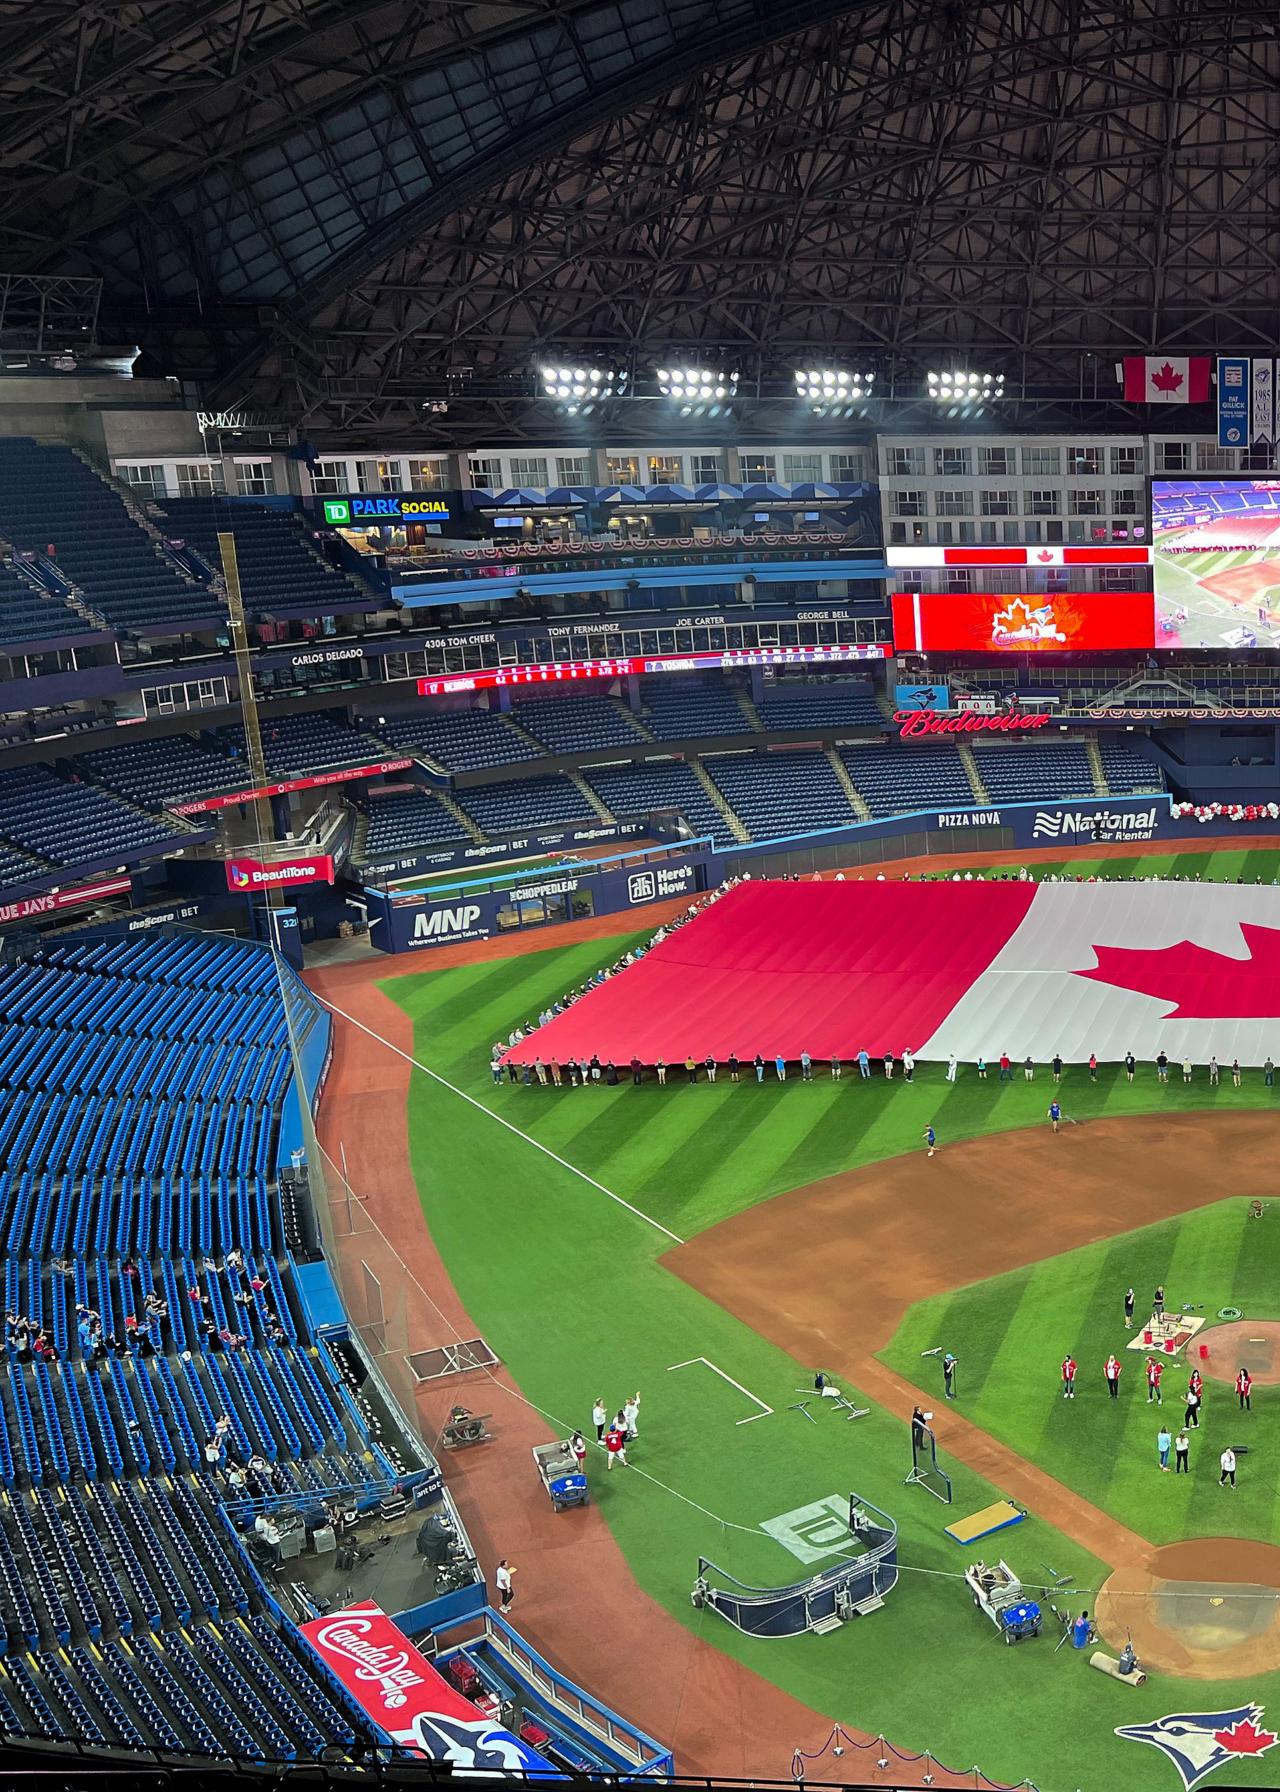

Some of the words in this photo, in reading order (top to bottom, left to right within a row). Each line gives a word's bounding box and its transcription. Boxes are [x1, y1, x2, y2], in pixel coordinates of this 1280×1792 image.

[1255, 389, 1271, 401] 1985
[326, 505, 347, 519] TD
[353, 499, 400, 515] PARK
[402, 501, 449, 514] SOCIAL
[676, 617, 692, 627] JOE
[695, 616, 725, 626] CARTER
[797, 611, 829, 620] GEORGE
[832, 610, 850, 619] BELL
[547, 626, 571, 637] TONY
[573, 623, 620, 635] FERNANDEZ
[425, 638, 447, 649] 4306
[447, 636, 468, 647] TOM
[469, 633, 496, 645] CHEEK
[292, 654, 324, 666] CARLOS
[326, 649, 363, 662] DELGADO
[893, 708, 1051, 737] Budweiser
[327, 775, 336, 783] you
[388, 759, 413, 771] ROGERS
[223, 796, 241, 805] Proud
[938, 813, 969, 828] PIZZA
[972, 811, 1000, 826] NOVA
[574, 827, 616, 840] theScore
[621, 824, 636, 833] BET
[1115, 829, 1152, 841] Rental
[465, 844, 507, 857] theScore
[512, 840, 528, 850] BET
[401, 858, 417, 869] BET
[252, 866, 316, 882] BeautiTone
[657, 865, 692, 883] Here's
[516, 880, 578, 900] CHOPPEDLEAF
[658, 879, 687, 895] How.
[22, 895, 56, 915] JAYS
[129, 911, 175, 931] theScore
[181, 905, 199, 918] BET
[414, 904, 481, 938] MNP
[408, 936, 436, 947] Wherever
[437, 933, 462, 944] Business
[463, 930, 477, 941] Takes
[478, 927, 489, 938] You
